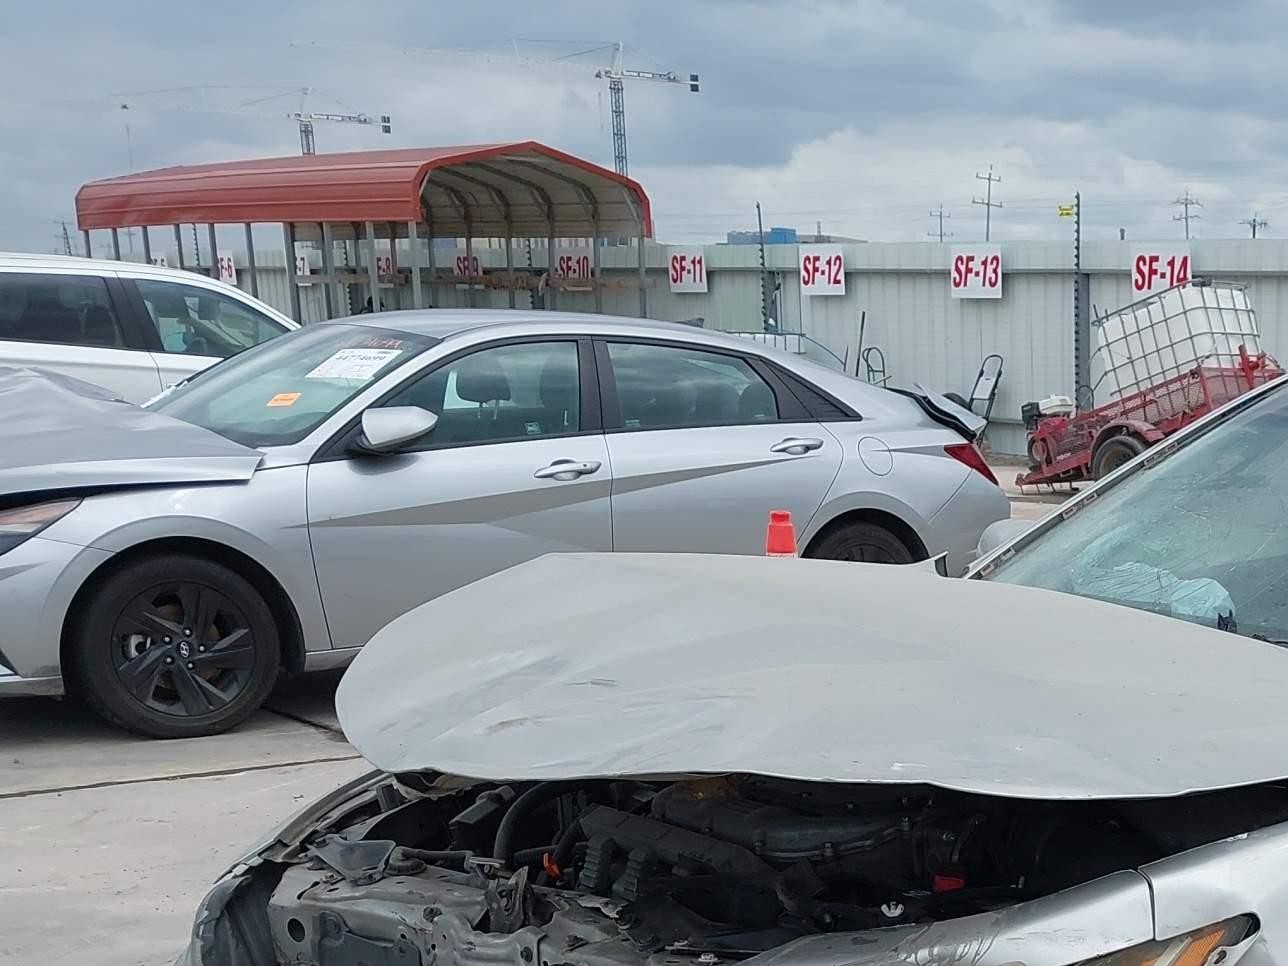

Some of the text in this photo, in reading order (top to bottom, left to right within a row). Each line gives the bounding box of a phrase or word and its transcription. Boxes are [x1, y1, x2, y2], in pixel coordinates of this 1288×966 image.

[671, 255, 702, 284] SF-11
[801, 255, 842, 286] SF-12
[952, 255, 1000, 288] SF-13
[1134, 254, 1189, 291] SF-14
